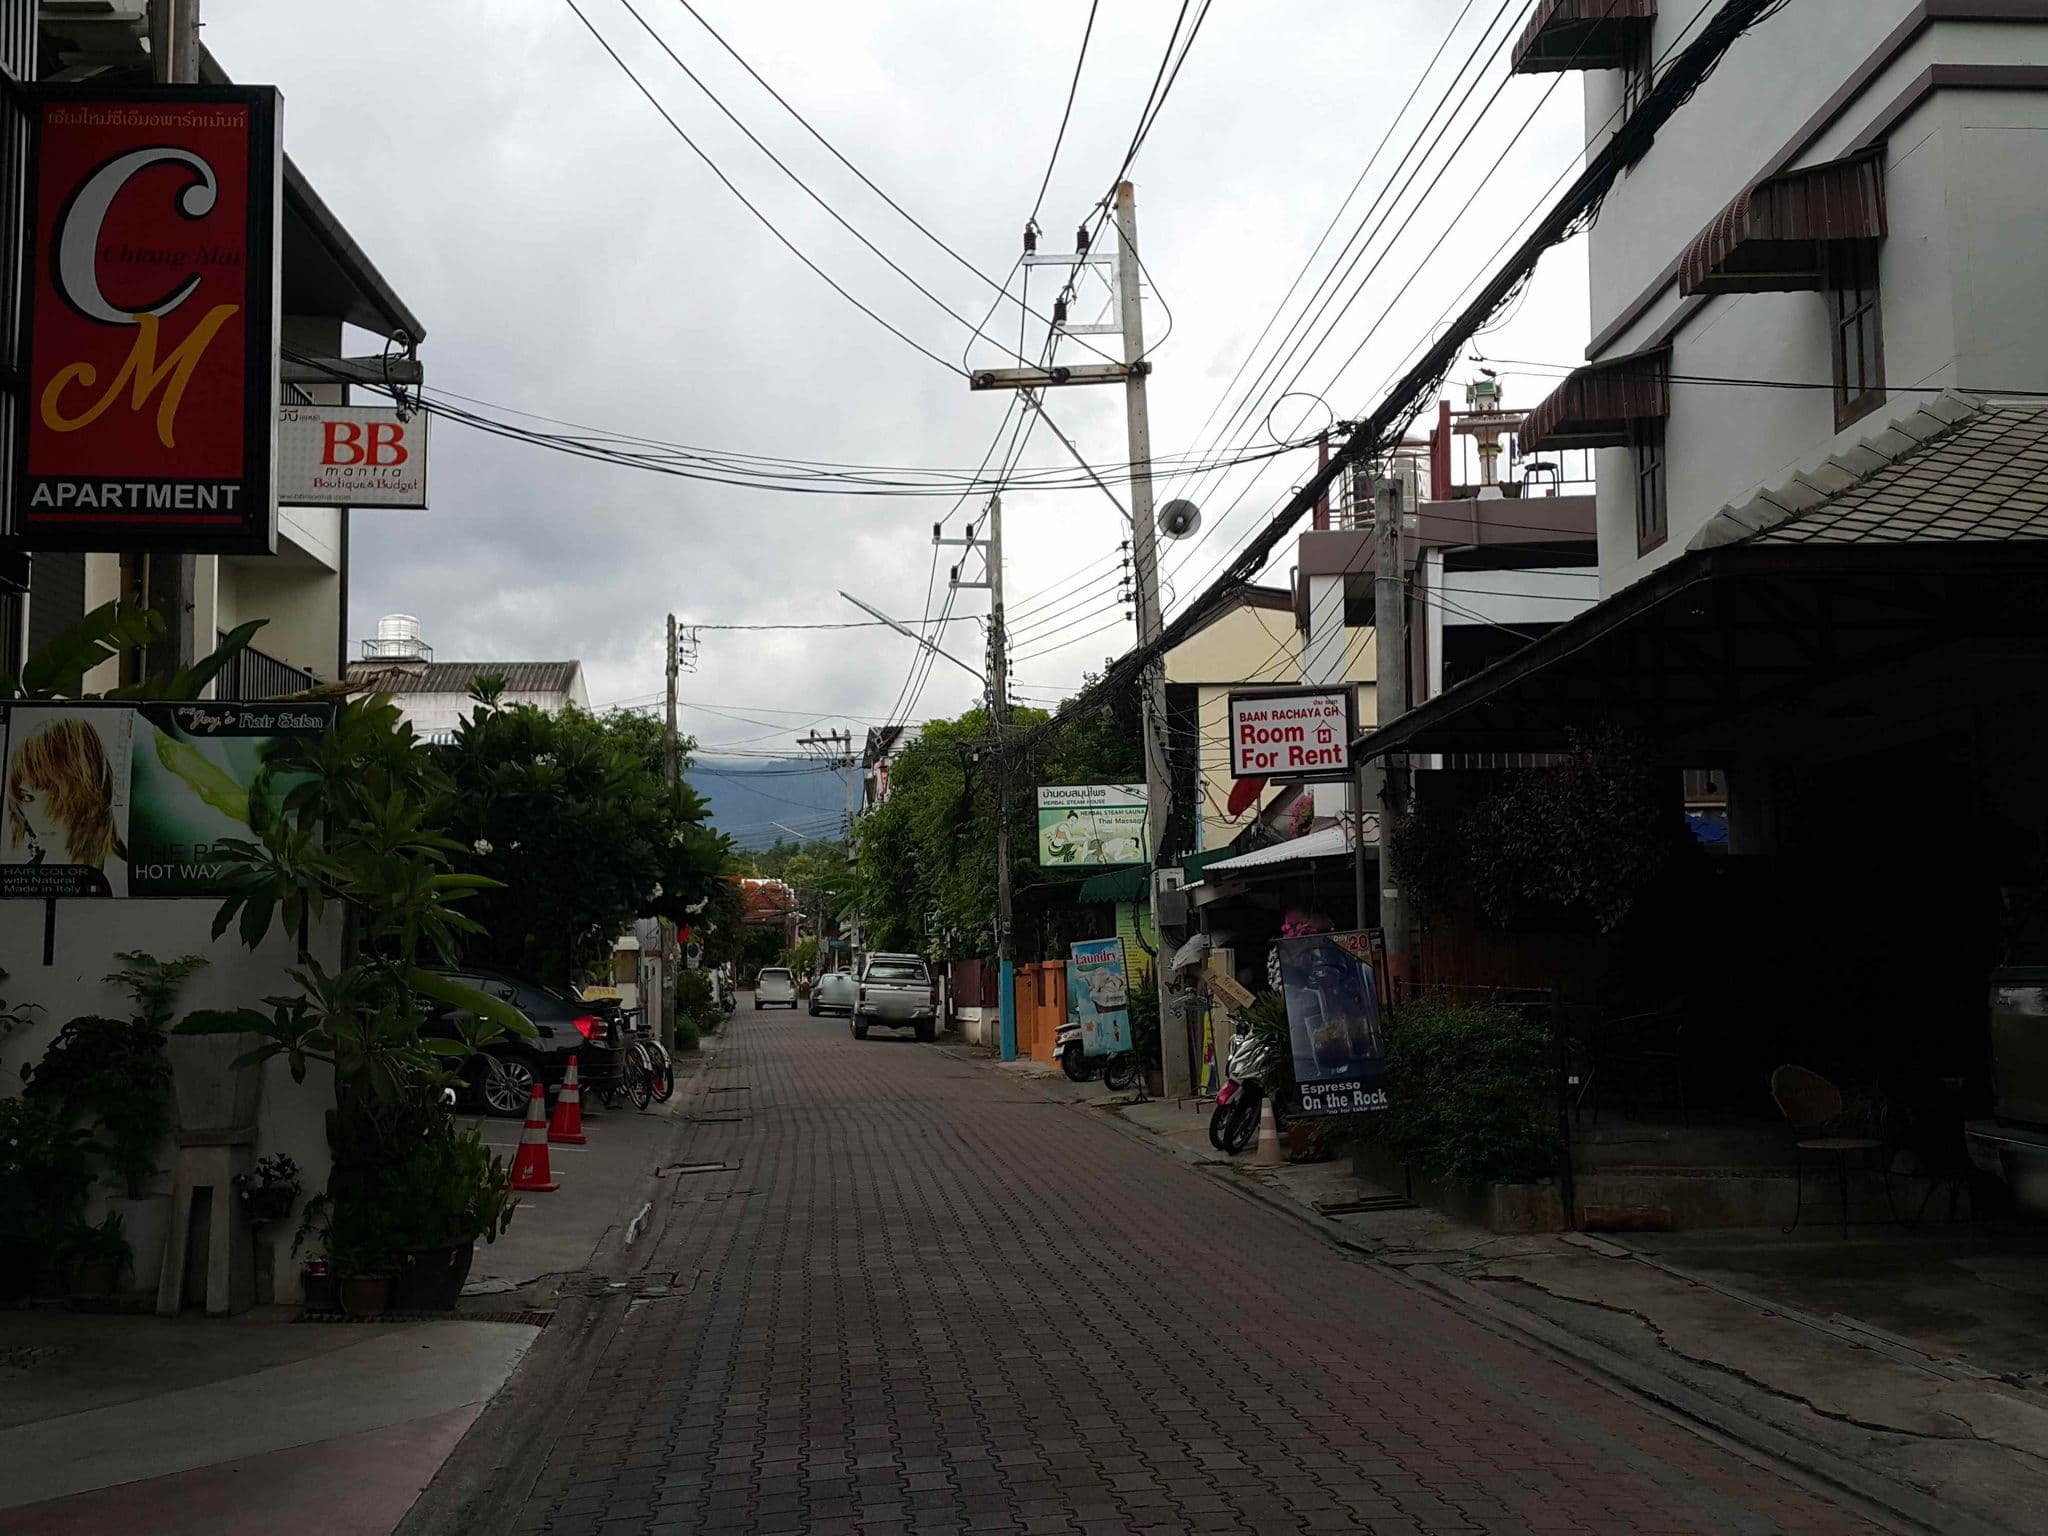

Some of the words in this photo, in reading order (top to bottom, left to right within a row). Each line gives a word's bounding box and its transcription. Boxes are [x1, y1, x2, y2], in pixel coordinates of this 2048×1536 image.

[320, 421, 409, 466] BB
[325, 467, 402, 477] mantra
[313, 477, 365, 491] Boutique
[366, 480, 375, 488] &
[377, 478, 418, 493] Budget
[30, 482, 241, 510] APARTMENT
[239, 712, 275, 728] Hair
[277, 712, 323, 728] Salon
[1239, 711, 1267, 722] BAAN
[1272, 707, 1321, 720] RACHAYA
[1324, 706, 1339, 717] GH
[1240, 724, 1305, 745] Room
[1242, 748, 1278, 769] For
[1289, 744, 1342, 766] Rent
[1042, 787, 1106, 800] บ้านอบสมุนไพร
[3, 867, 36, 876] HAIR
[39, 867, 89, 876] COLOR
[135, 864, 175, 879] HOT
[3, 876, 28, 884] with
[31, 876, 76, 884] Natural
[4, 885, 39, 894] Made
[42, 885, 53, 894] in
[1348, 934, 1368, 950] 20
[1075, 951, 1117, 965] Laundry
[1300, 1081, 1361, 1095] Espresso
[1302, 1095, 1321, 1111] On
[1326, 1093, 1348, 1108] the
[1353, 1089, 1388, 1106] Rock
